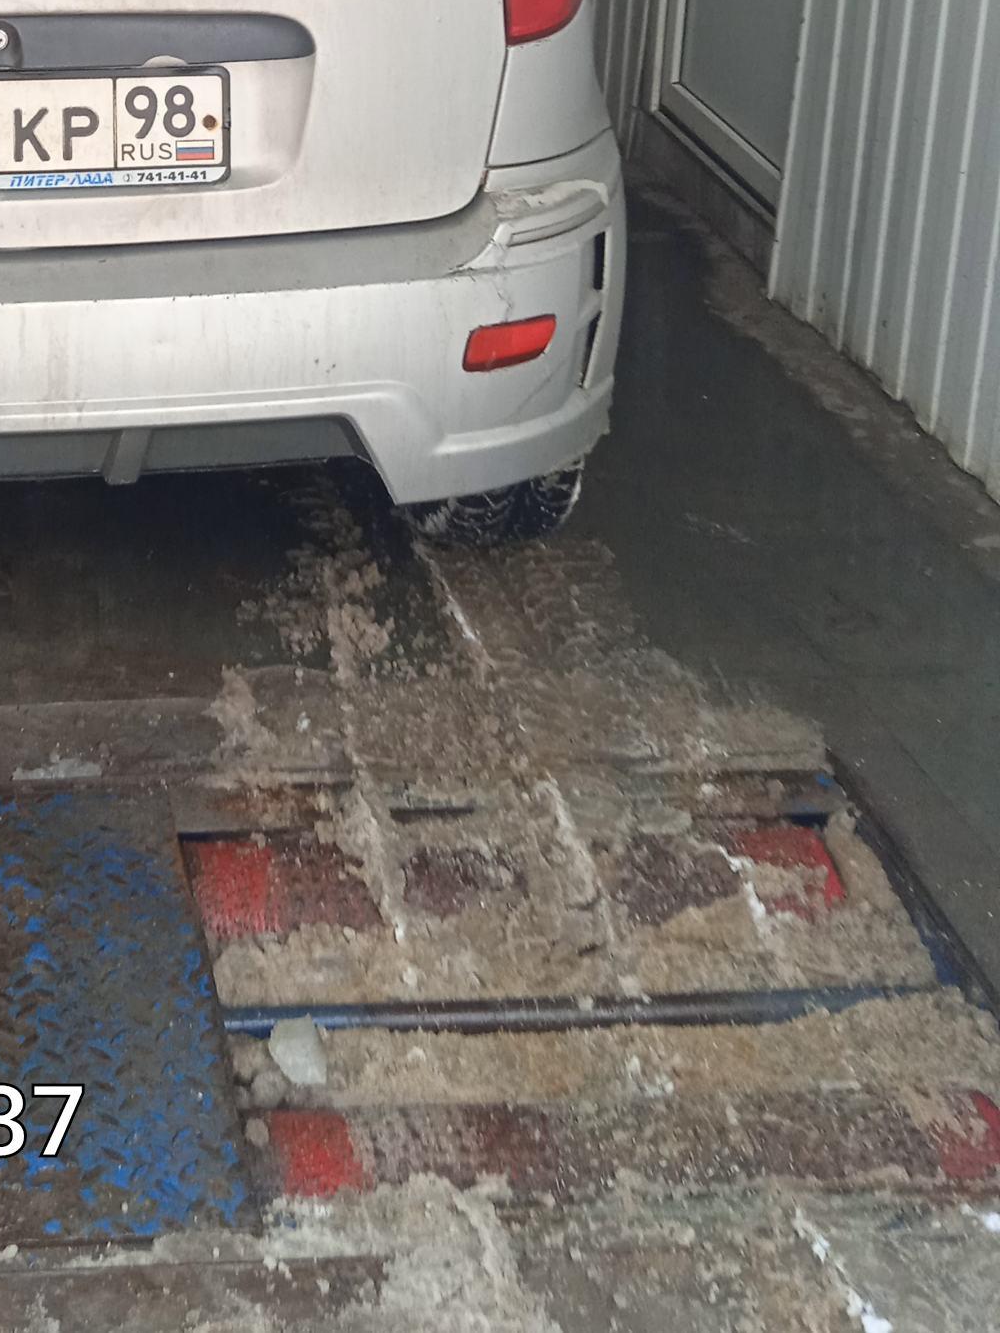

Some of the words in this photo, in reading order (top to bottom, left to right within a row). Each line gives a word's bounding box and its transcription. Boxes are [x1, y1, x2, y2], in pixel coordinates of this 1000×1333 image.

[124, 84, 196, 140] 98
[121, 143, 173, 162] RUS
[136, 170, 208, 183] 741-41-41
